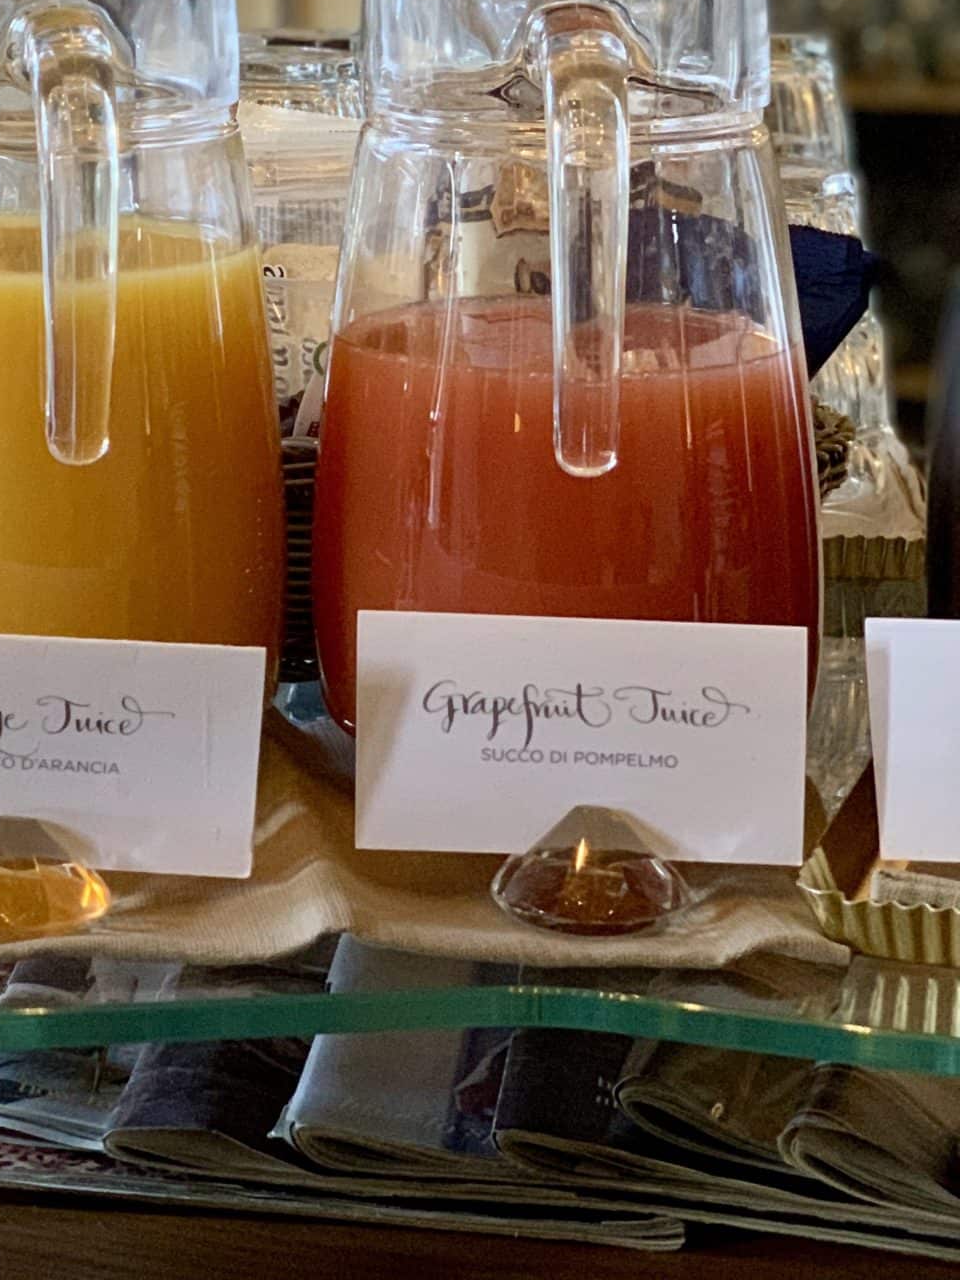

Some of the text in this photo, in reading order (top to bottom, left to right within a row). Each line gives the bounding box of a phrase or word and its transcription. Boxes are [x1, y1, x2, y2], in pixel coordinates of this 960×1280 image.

[37, 695, 175, 736] Juice
[422, 679, 751, 750] Grapefruit Juice
[20, 755, 121, 775] D'ARANCIA
[480, 747, 679, 769] SUCCO DI POMPELMO
